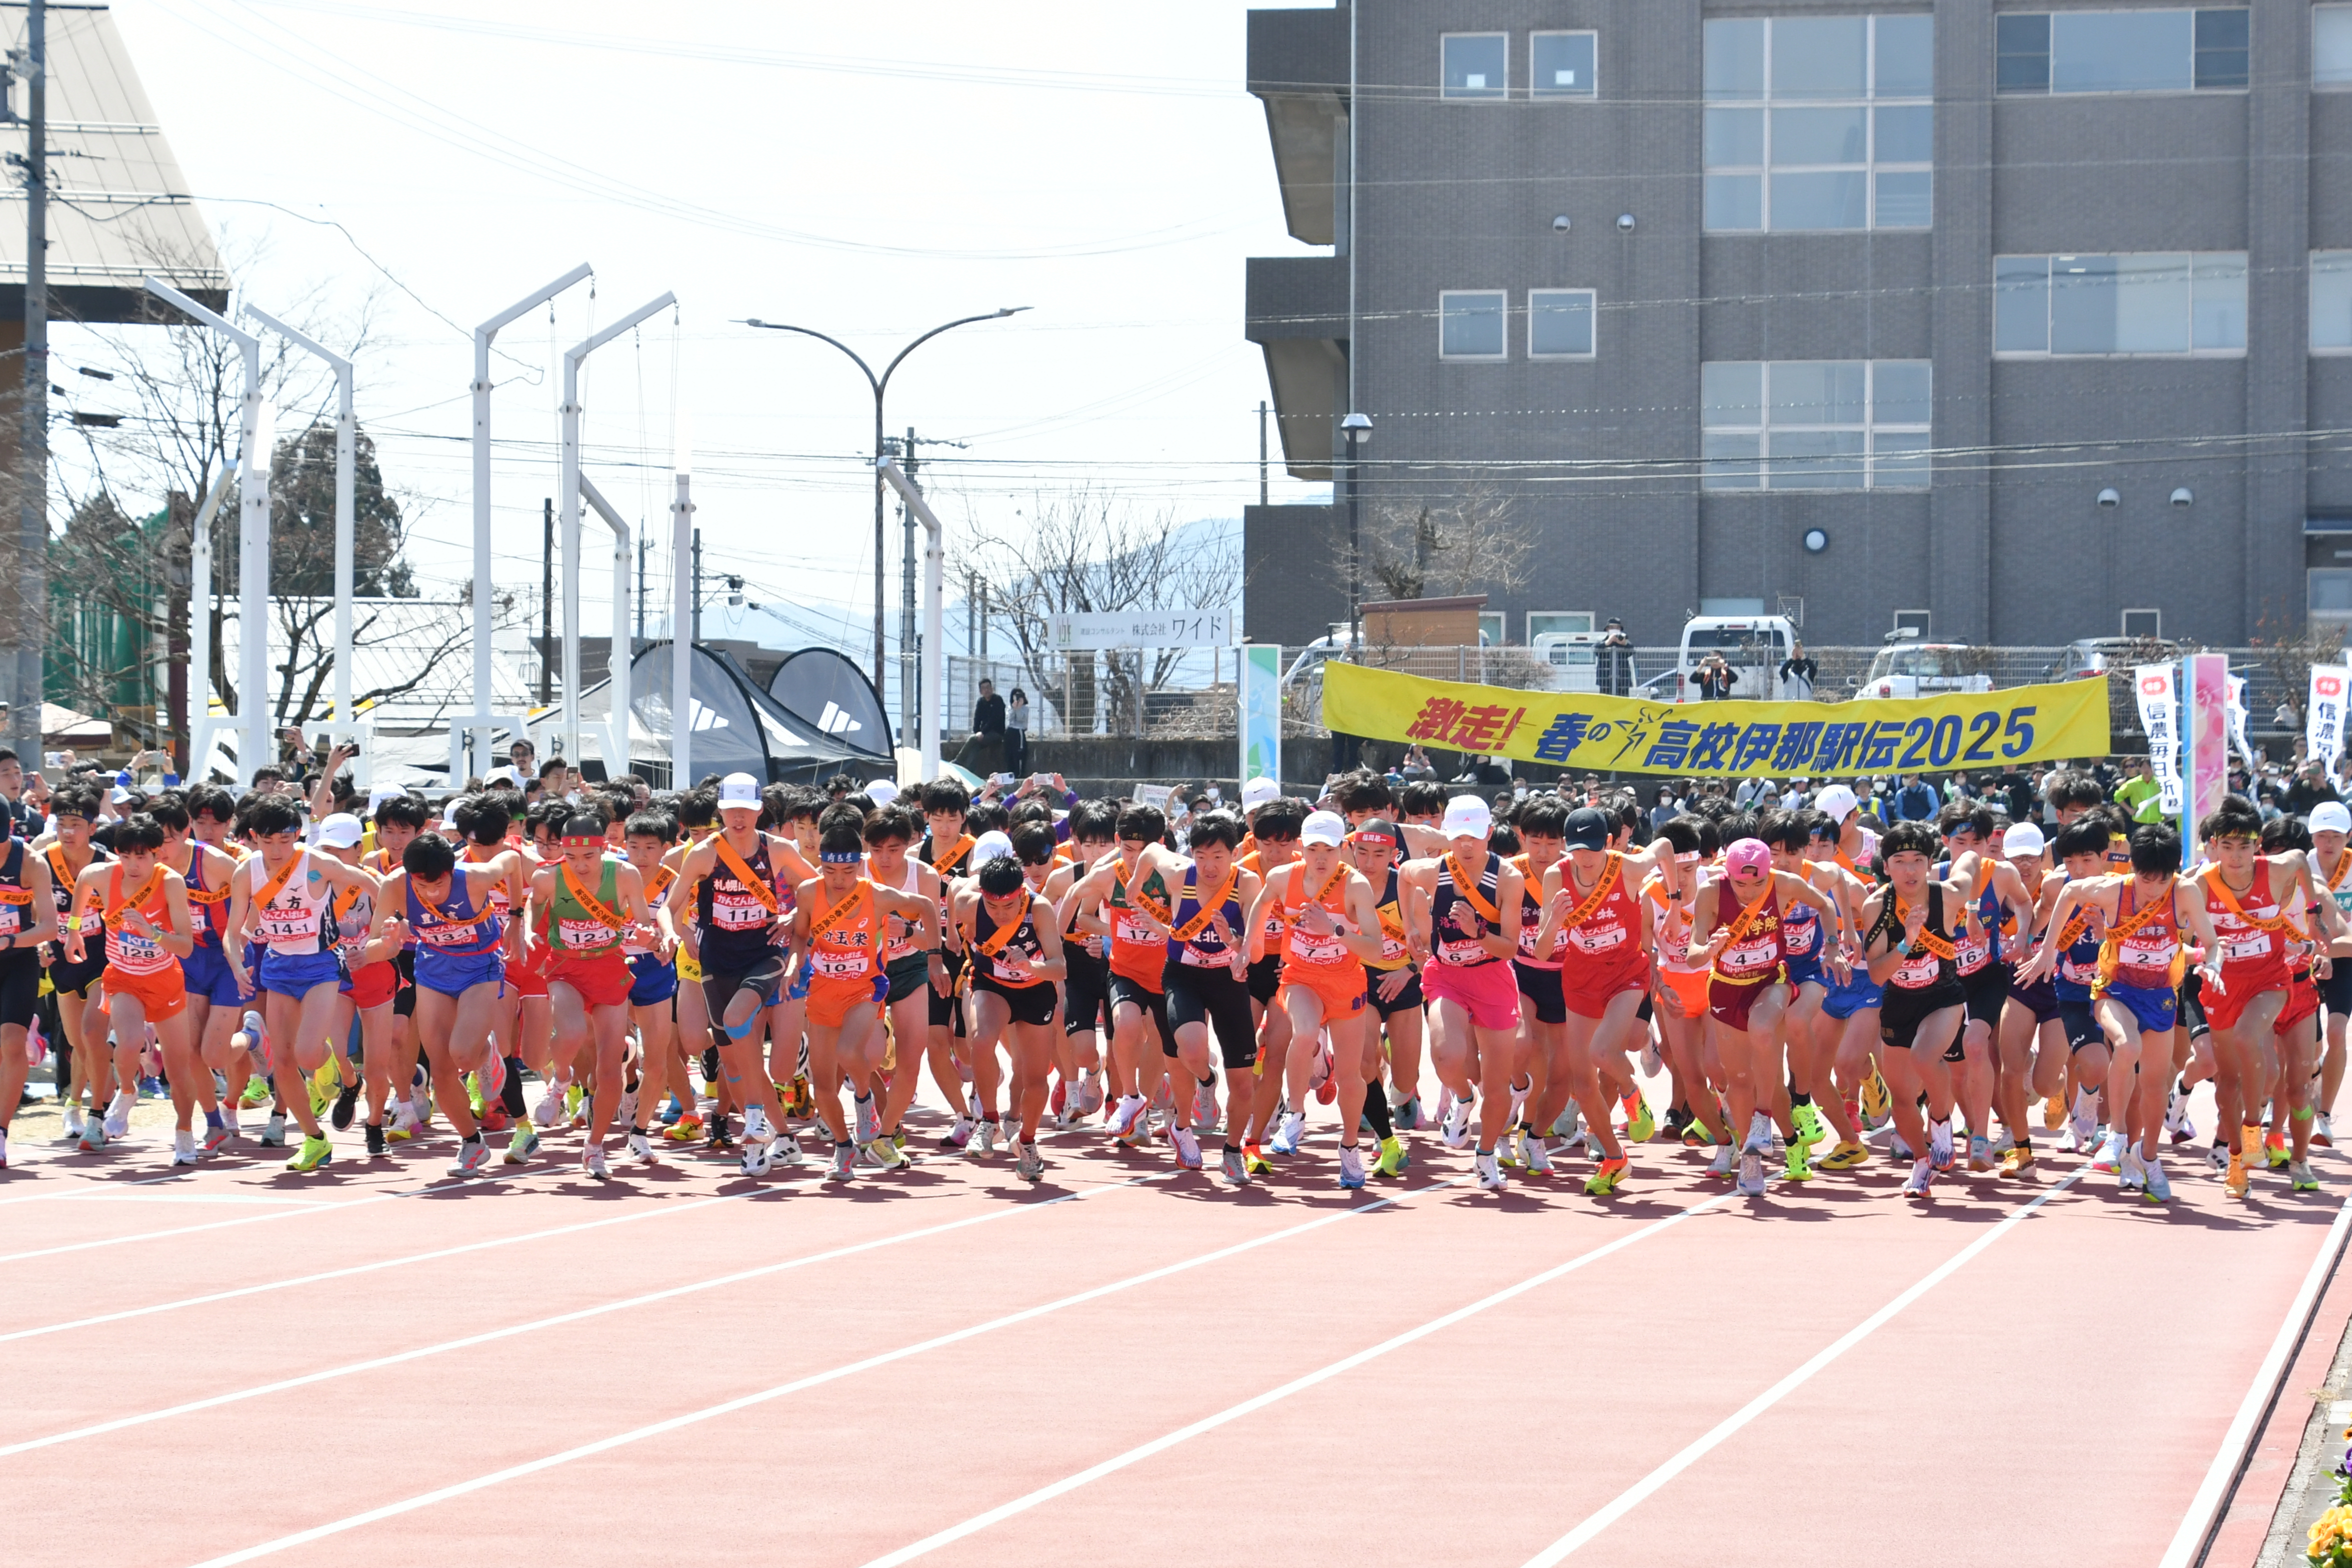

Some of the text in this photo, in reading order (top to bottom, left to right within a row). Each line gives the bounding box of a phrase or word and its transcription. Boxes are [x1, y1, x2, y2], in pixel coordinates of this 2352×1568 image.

[1132, 622, 1167, 636] 株式会社
[1172, 616, 1222, 640] ワイド
[1642, 706, 2037, 773] 高校伊那駅伝2025
[1607, 854, 1620, 876] 第48回
[714, 879, 771, 892] 札幌山手
[728, 910, 762, 922] 11-1
[270, 923, 308, 934] 14-1
[1440, 916, 1488, 930] 洛南校
[430, 928, 470, 942] 13-1
[572, 930, 610, 943] 12-1
[1128, 930, 1160, 940] 17-
[1190, 930, 1224, 943] 東北
[2132, 926, 2167, 936] 台育英
[1584, 934, 1618, 948] 5-1
[1785, 933, 1812, 948] 2-1
[122, 946, 166, 958] 128-
[1304, 947, 1340, 957] 7-1
[2230, 942, 2262, 956] 1-1
[1450, 950, 1484, 962] 6-1
[1734, 950, 1770, 965] 4-1
[2136, 952, 2172, 964] 2-1
[823, 962, 861, 973] 10-1
[1898, 968, 1932, 980] 3-1
